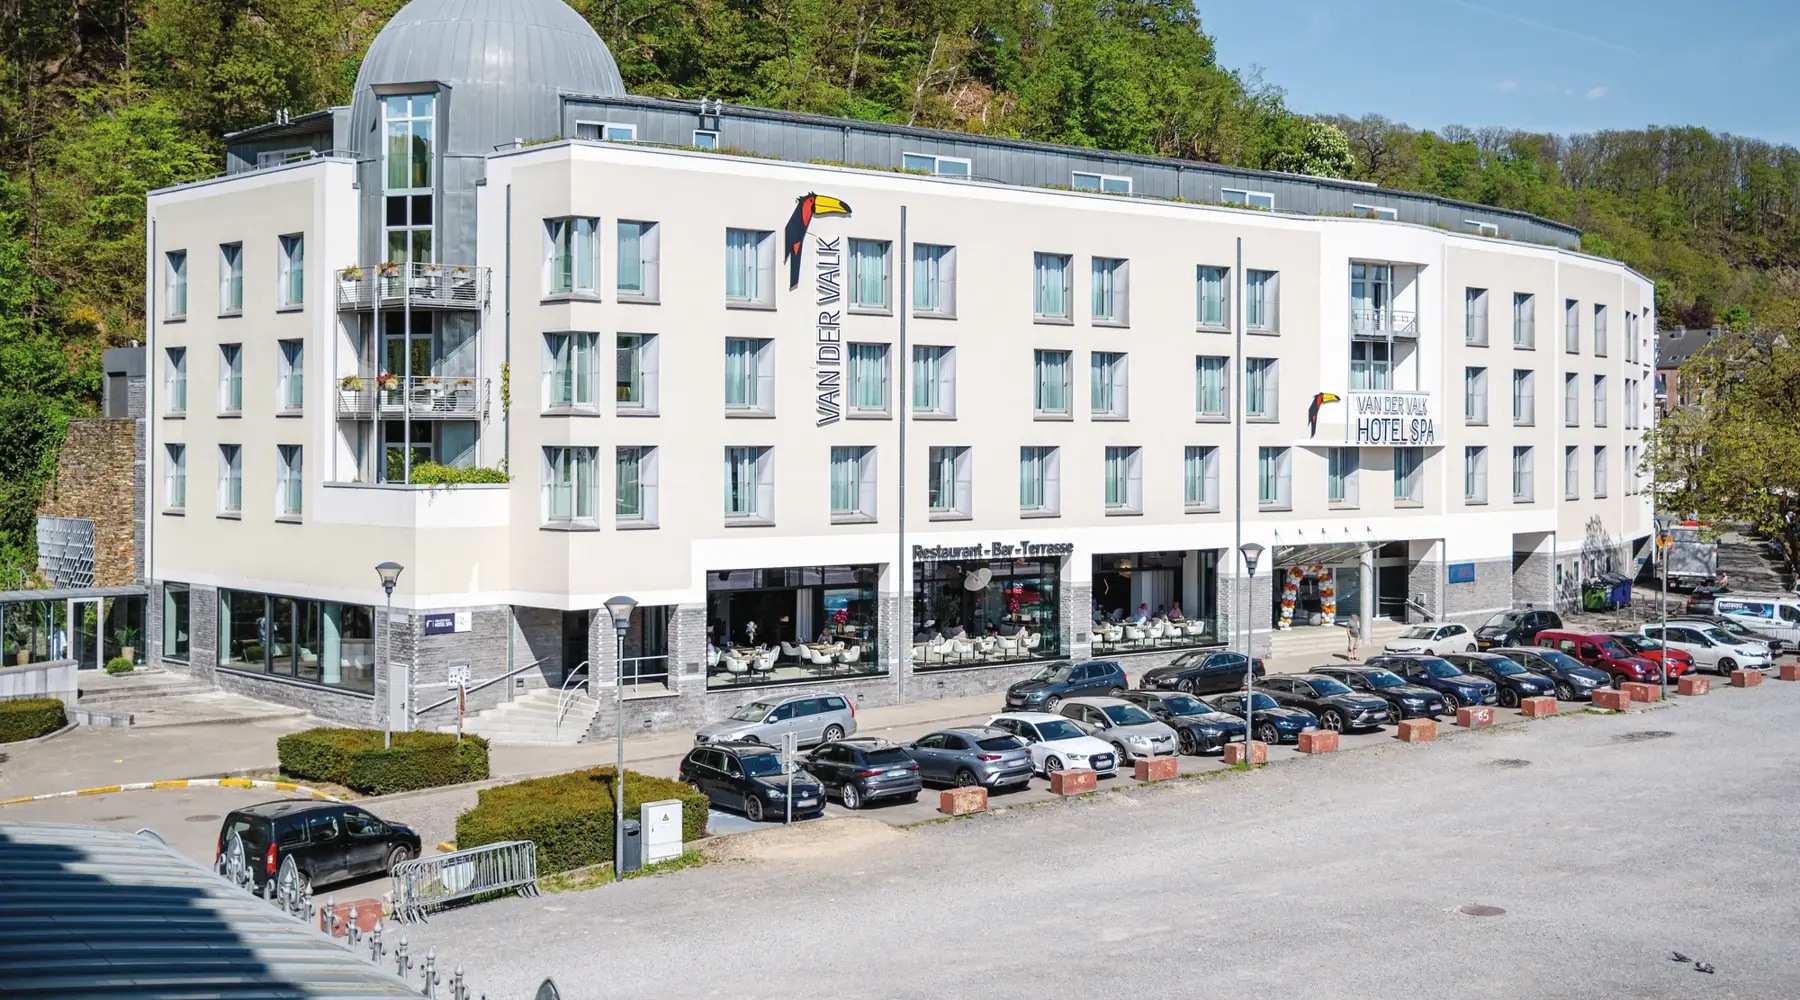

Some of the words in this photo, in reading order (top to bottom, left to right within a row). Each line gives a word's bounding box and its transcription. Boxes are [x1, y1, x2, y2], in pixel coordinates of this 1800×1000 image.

[818, 236, 840, 302] VALK
[818, 311, 840, 361] DER
[818, 371, 840, 423] VAN
[1356, 396, 1382, 412] VAN
[1385, 396, 1404, 412] DER
[1406, 397, 1427, 413] VALK
[1358, 418, 1408, 442] HOTEL
[1411, 418, 1434, 442] SPA
[912, 543, 983, 560] Restaurant
[992, 541, 1014, 557] Bar
[1020, 540, 1074, 555] Terrasse
